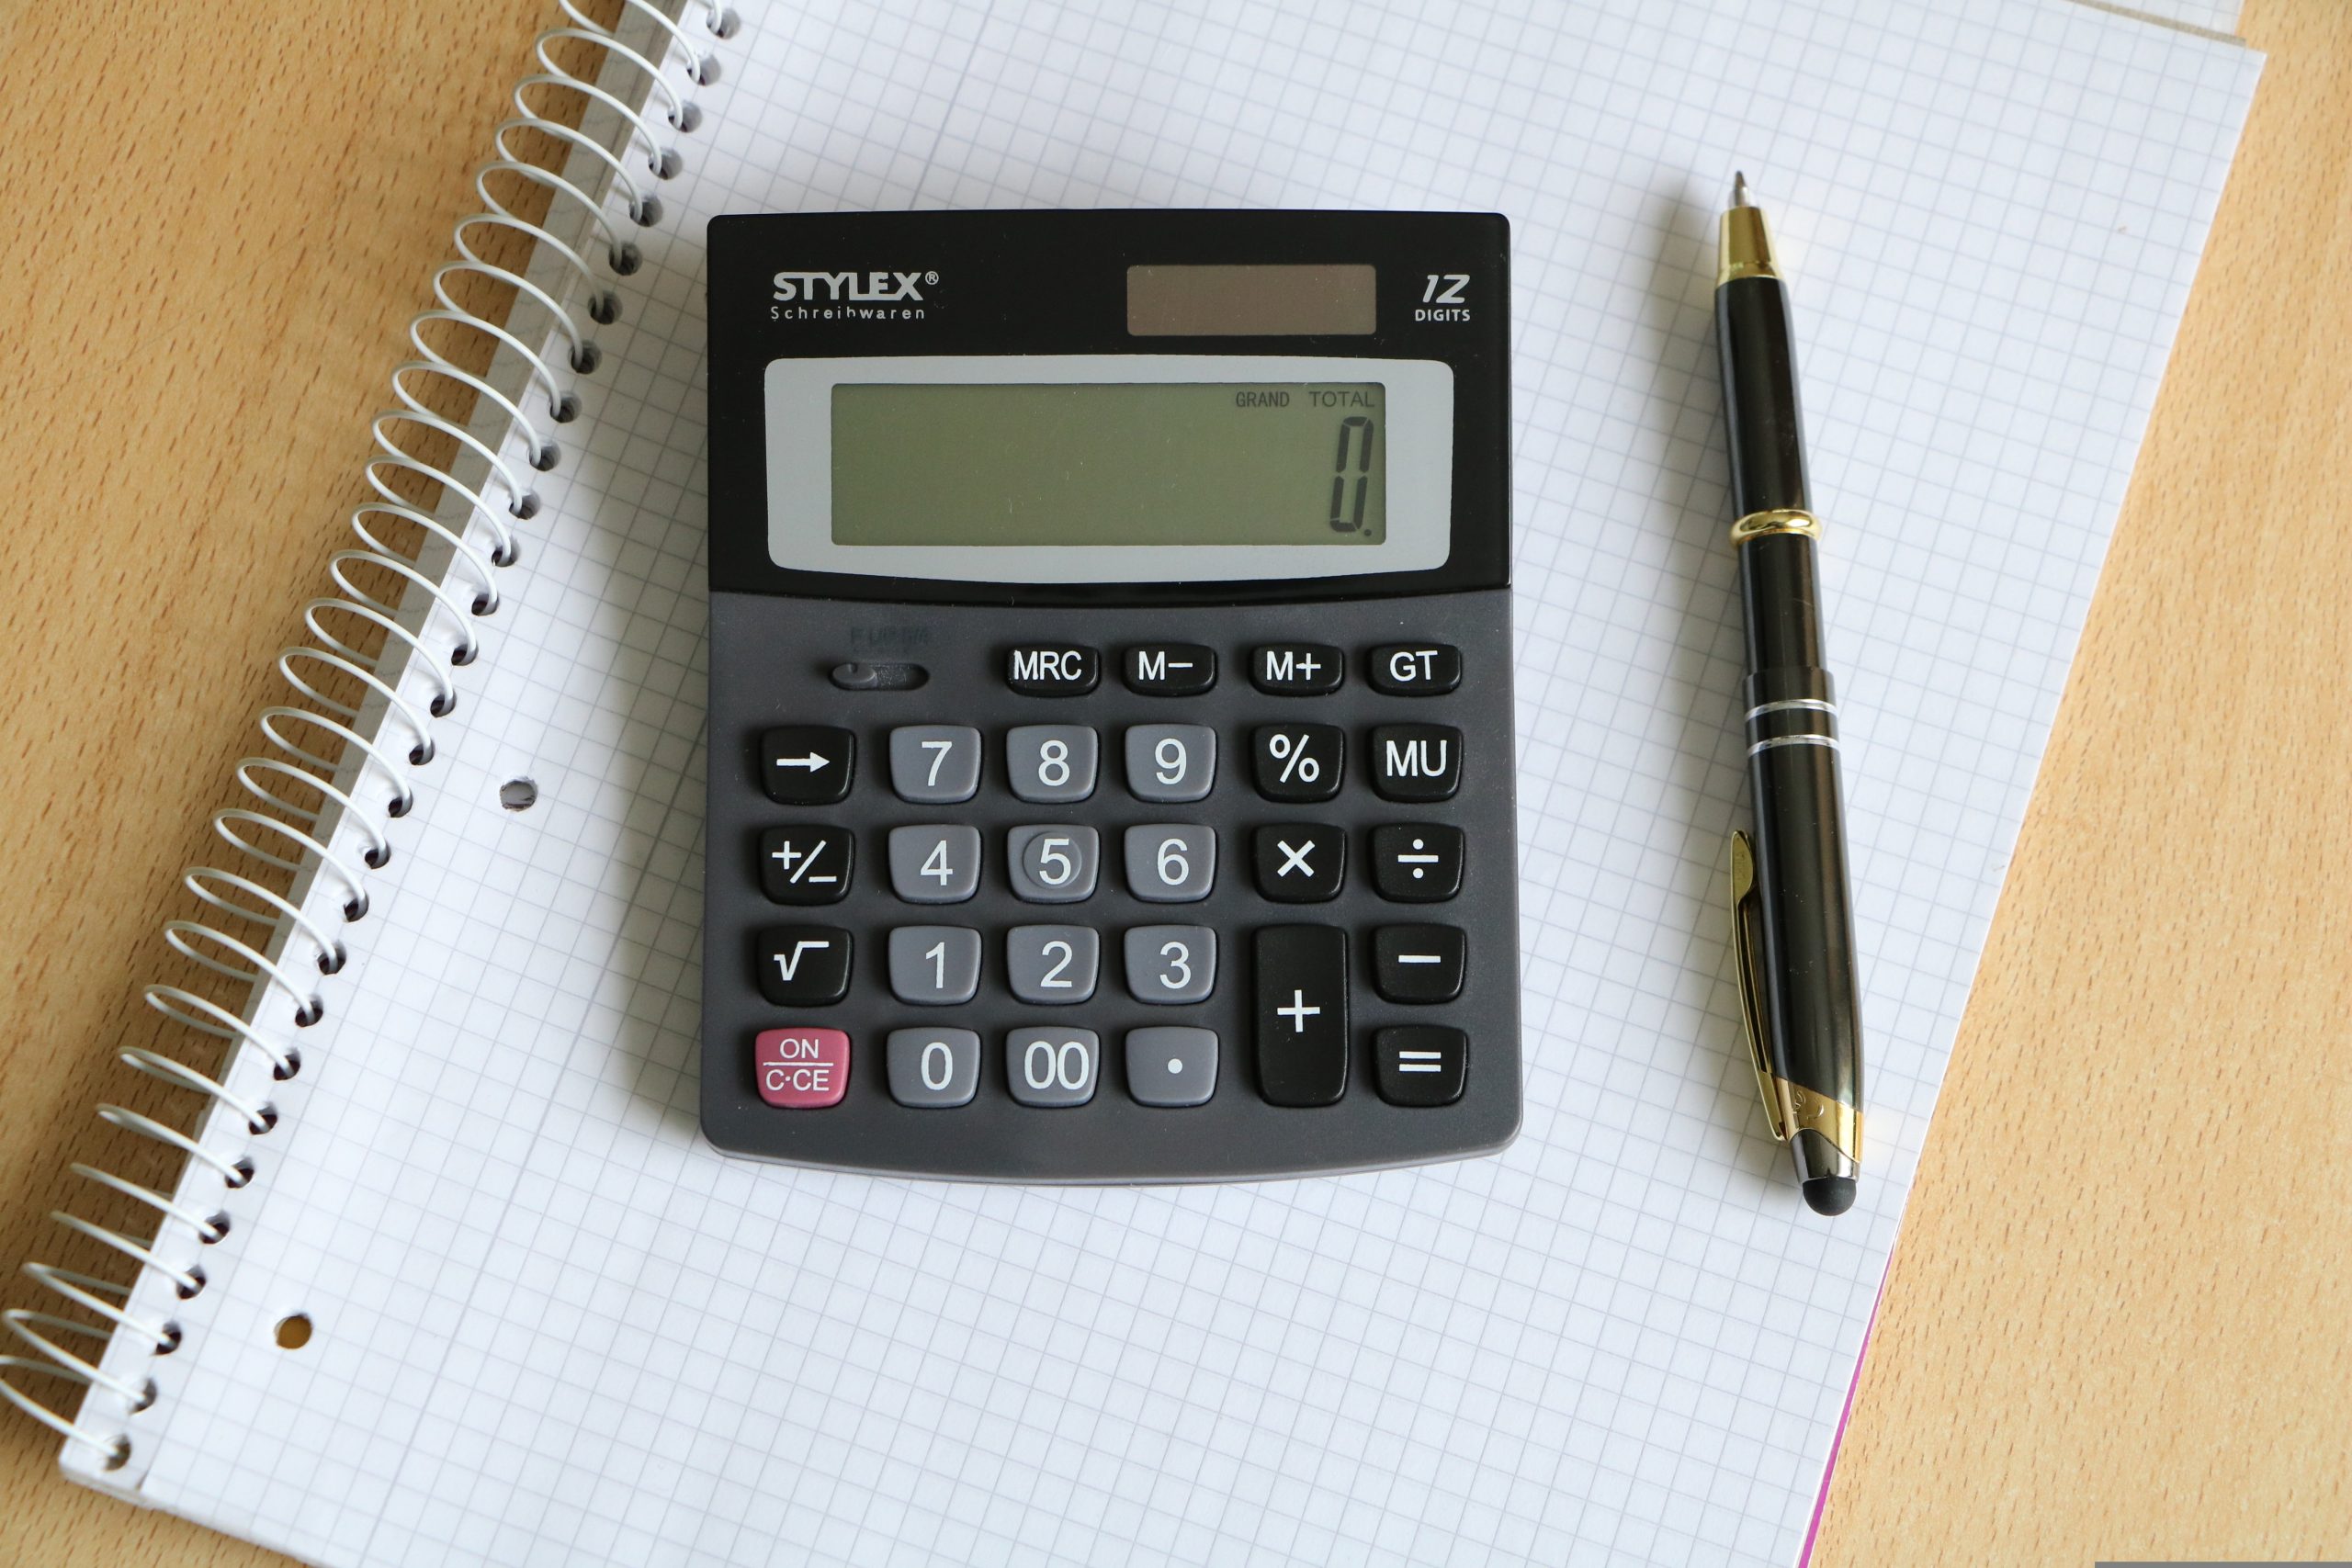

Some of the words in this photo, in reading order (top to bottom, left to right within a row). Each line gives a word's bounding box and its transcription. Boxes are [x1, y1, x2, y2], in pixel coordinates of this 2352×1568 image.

[1415, 309, 1471, 322] DIGITS
[1236, 390, 1290, 408] GRAND
[1308, 390, 1375, 408] TOTAL
[1013, 649, 1082, 681] MRC
[1266, 650, 1321, 681] M+
[1389, 650, 1438, 682] GT
[922, 740, 953, 786] 7
[1038, 739, 1070, 786] 8
[1155, 738, 1187, 784] 9
[1269, 734, 1320, 783] %
[1386, 739, 1447, 777] MU
[920, 840, 954, 886] 4
[1039, 838, 1071, 886] 5
[1157, 838, 1190, 886] 6
[925, 942, 945, 989] 1
[1040, 941, 1073, 987] 2
[1159, 942, 1192, 989] 3
[780, 1038, 819, 1059] ON
[921, 1042, 954, 1090] 0
[1023, 1040, 1090, 1090] 00
